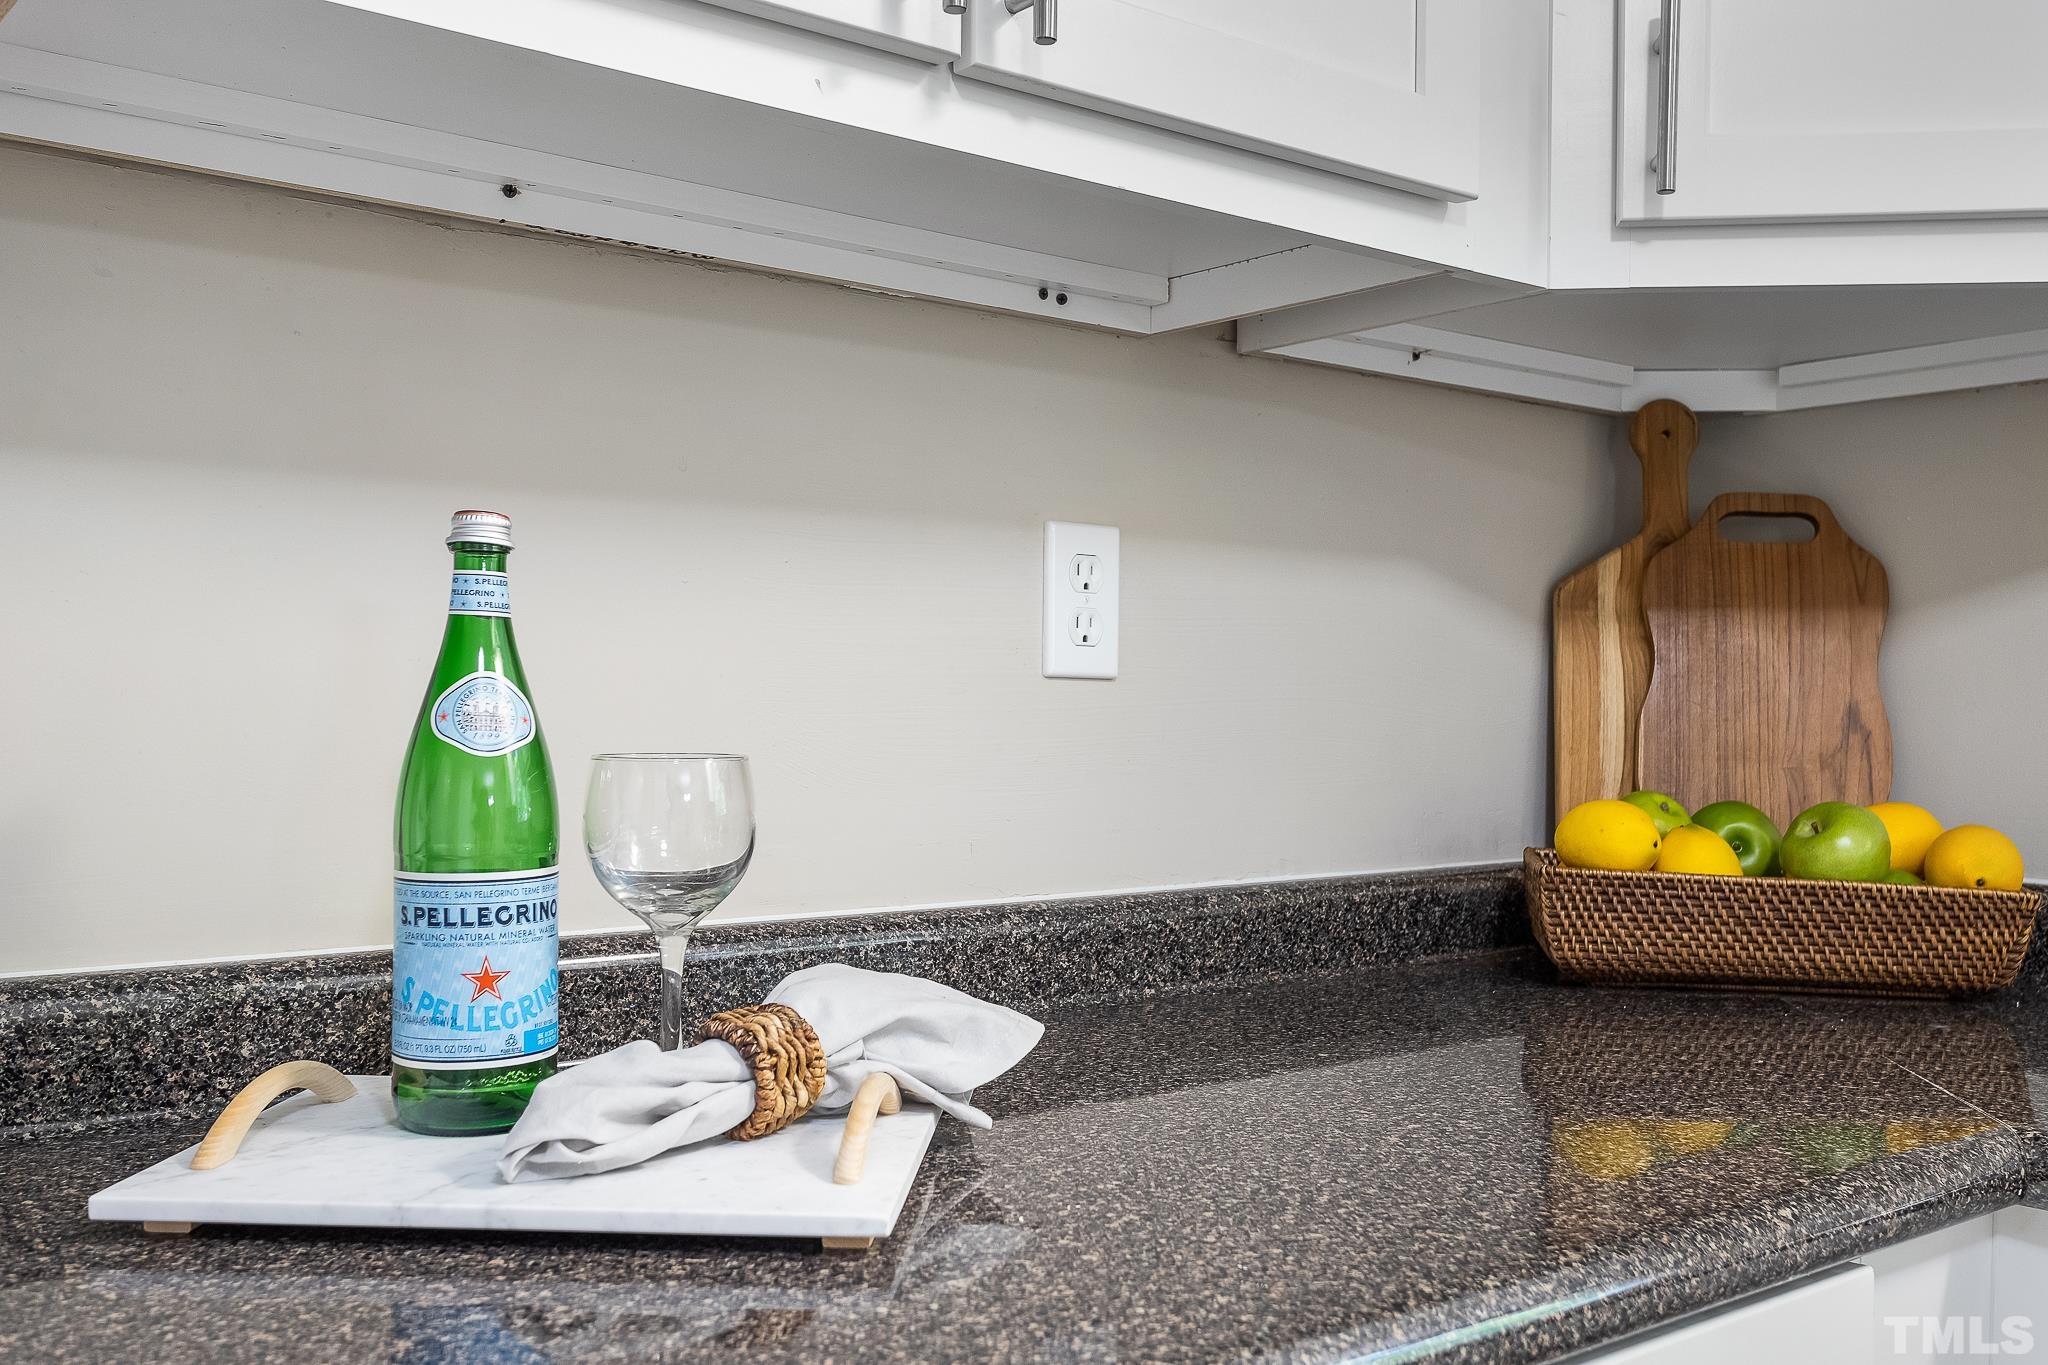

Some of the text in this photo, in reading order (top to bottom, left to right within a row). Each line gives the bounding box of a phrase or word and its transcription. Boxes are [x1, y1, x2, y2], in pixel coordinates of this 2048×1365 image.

[454, 890, 472, 899] SAN
[474, 888, 519, 899] PELLEGRINO
[401, 898, 558, 929] S.PELLEGRINO
[404, 930, 447, 942] SPARKLING
[450, 932, 495, 942] NATURAL
[498, 928, 536, 941] MINERAL
